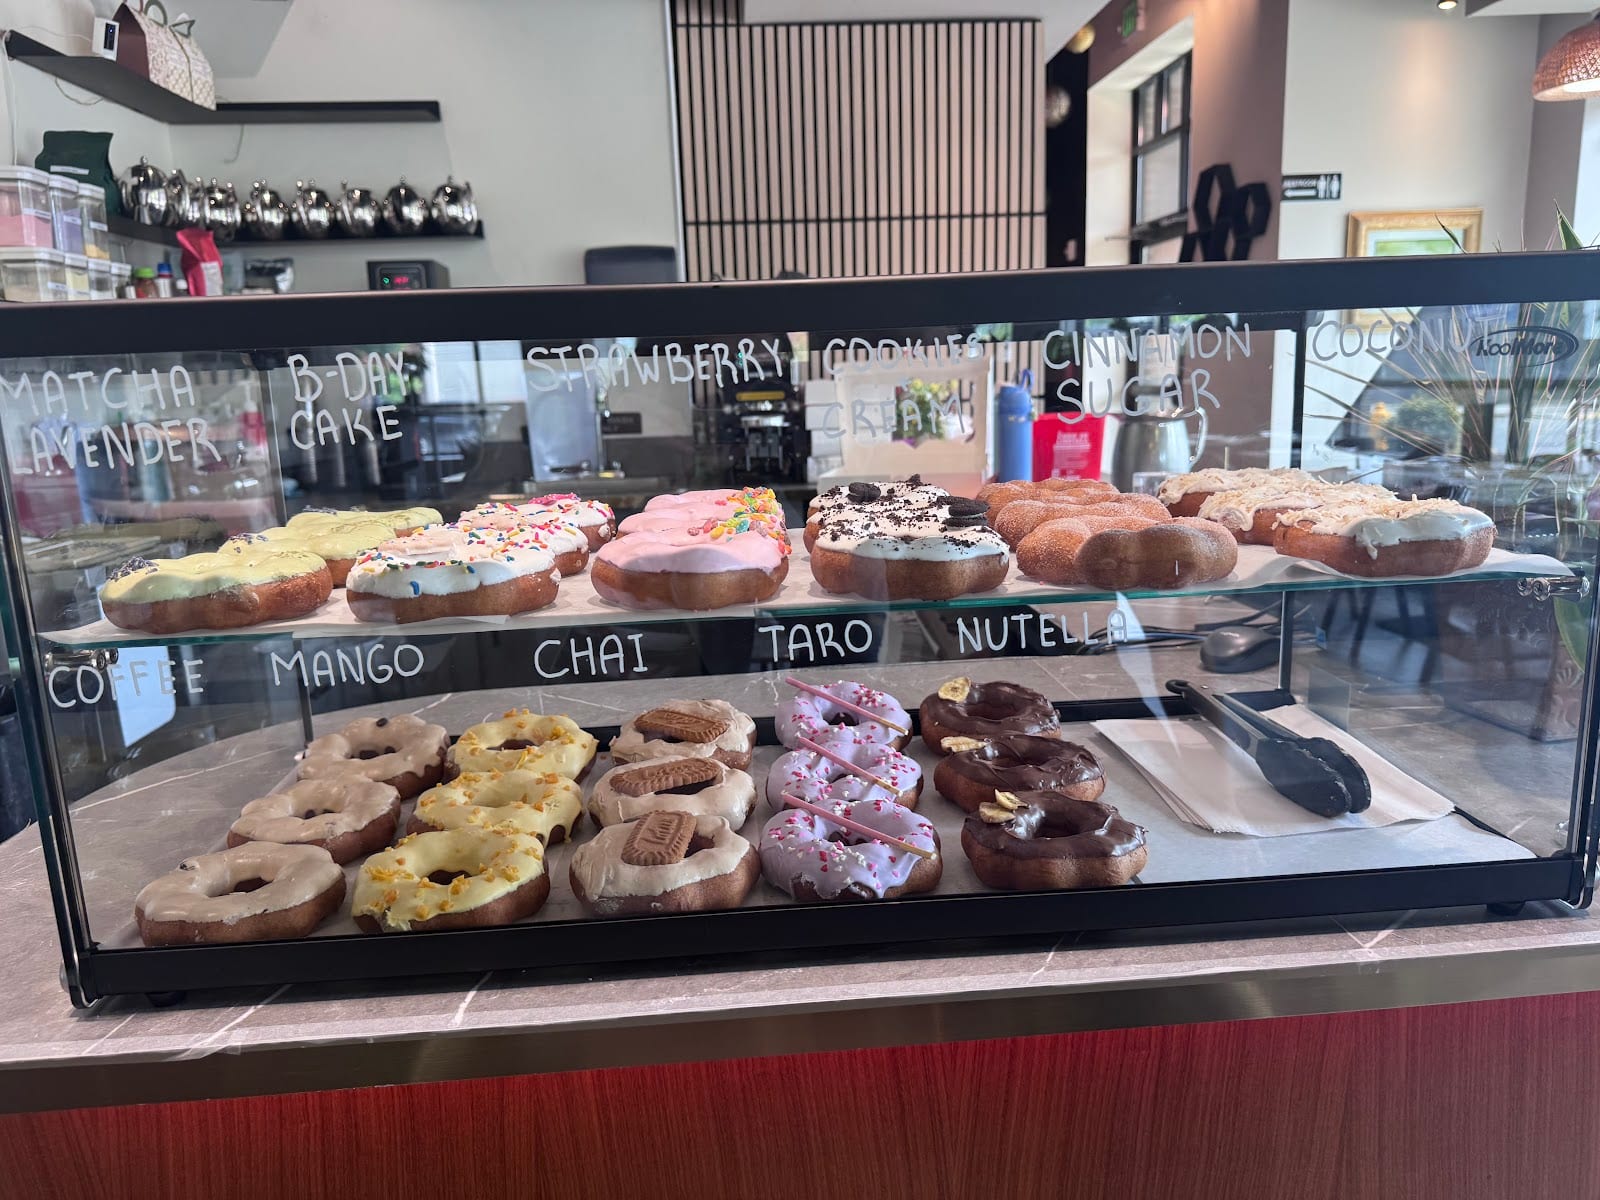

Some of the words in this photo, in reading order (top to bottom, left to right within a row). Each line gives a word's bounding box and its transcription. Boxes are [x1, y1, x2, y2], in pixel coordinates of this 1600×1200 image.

[822, 332, 985, 375] COOKIES
[1042, 323, 1252, 370] CINNAMON
[1312, 315, 1508, 361] COCONUT
[287, 351, 408, 402] B-DAY
[526, 337, 783, 392] STRAWBERRY
[0, 365, 195, 416] MATCHA
[1056, 368, 1220, 425] SUGAR
[290, 405, 403, 450] CAKE
[822, 394, 966, 439] CREAM
[5, 417, 222, 475] LAVENDER
[758, 619, 873, 663] TARO
[956, 608, 1130, 654] NUTELLA
[271, 643, 425, 687] MANGO
[533, 633, 648, 679] CHAI
[47, 658, 205, 709] COFFEE
